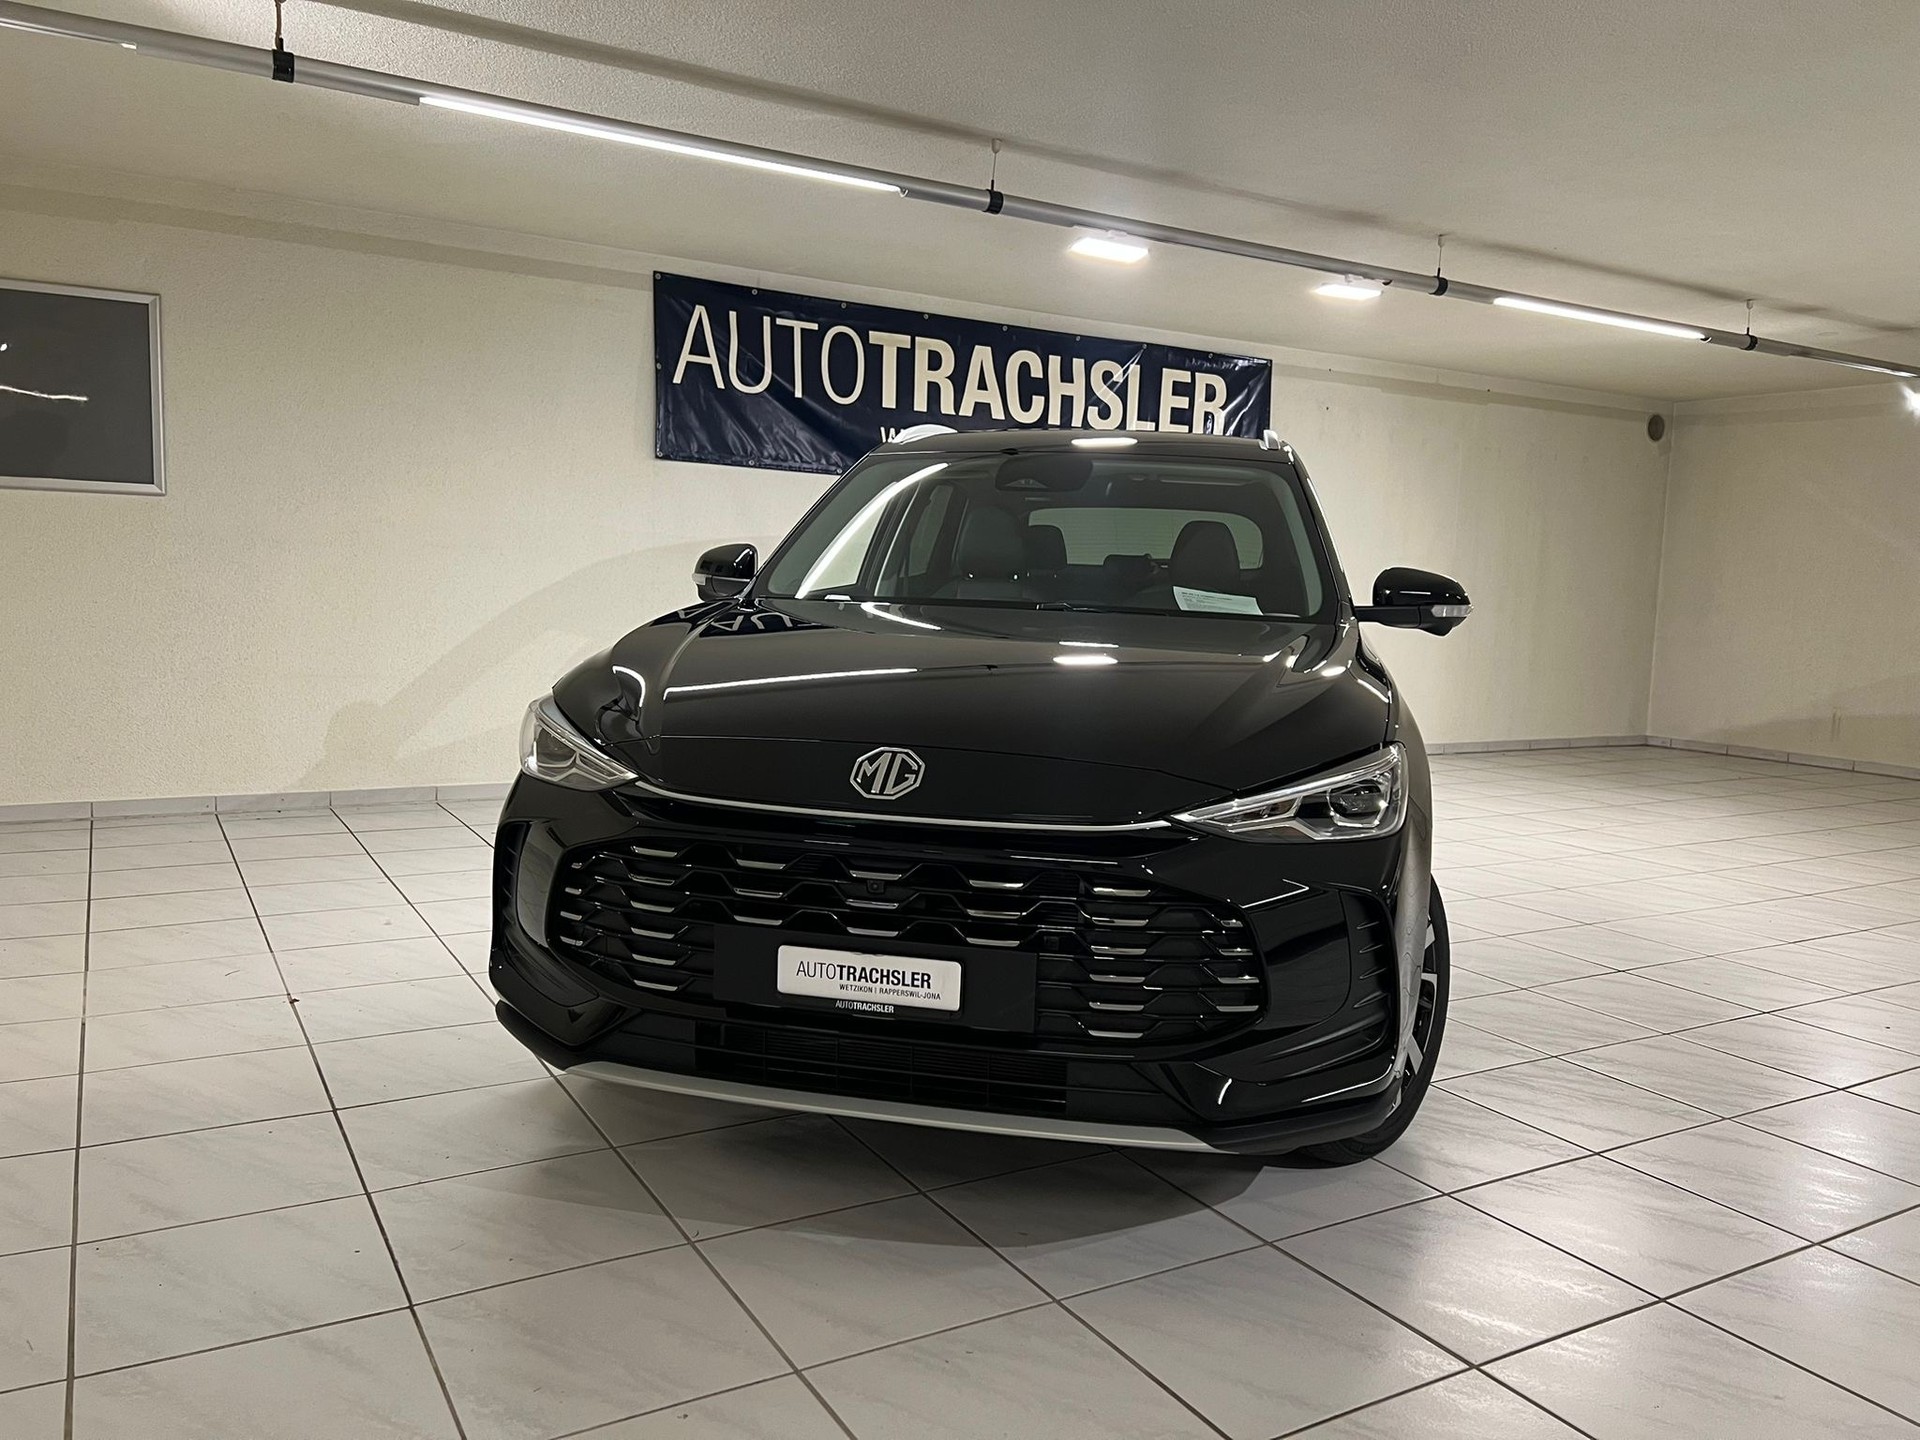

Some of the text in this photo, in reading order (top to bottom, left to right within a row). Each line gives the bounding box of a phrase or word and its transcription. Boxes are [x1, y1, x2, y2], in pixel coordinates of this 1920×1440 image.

[672, 304, 1228, 436] AUTOTRACHSLER
[856, 752, 918, 795] MG
[796, 960, 931, 989] AUTOTRACHSLER
[835, 999, 894, 1013] AUTOTRACHSLER
[839, 983, 873, 994] WETZIKON
[879, 987, 941, 1001] RAPPERSWIL-JONA
